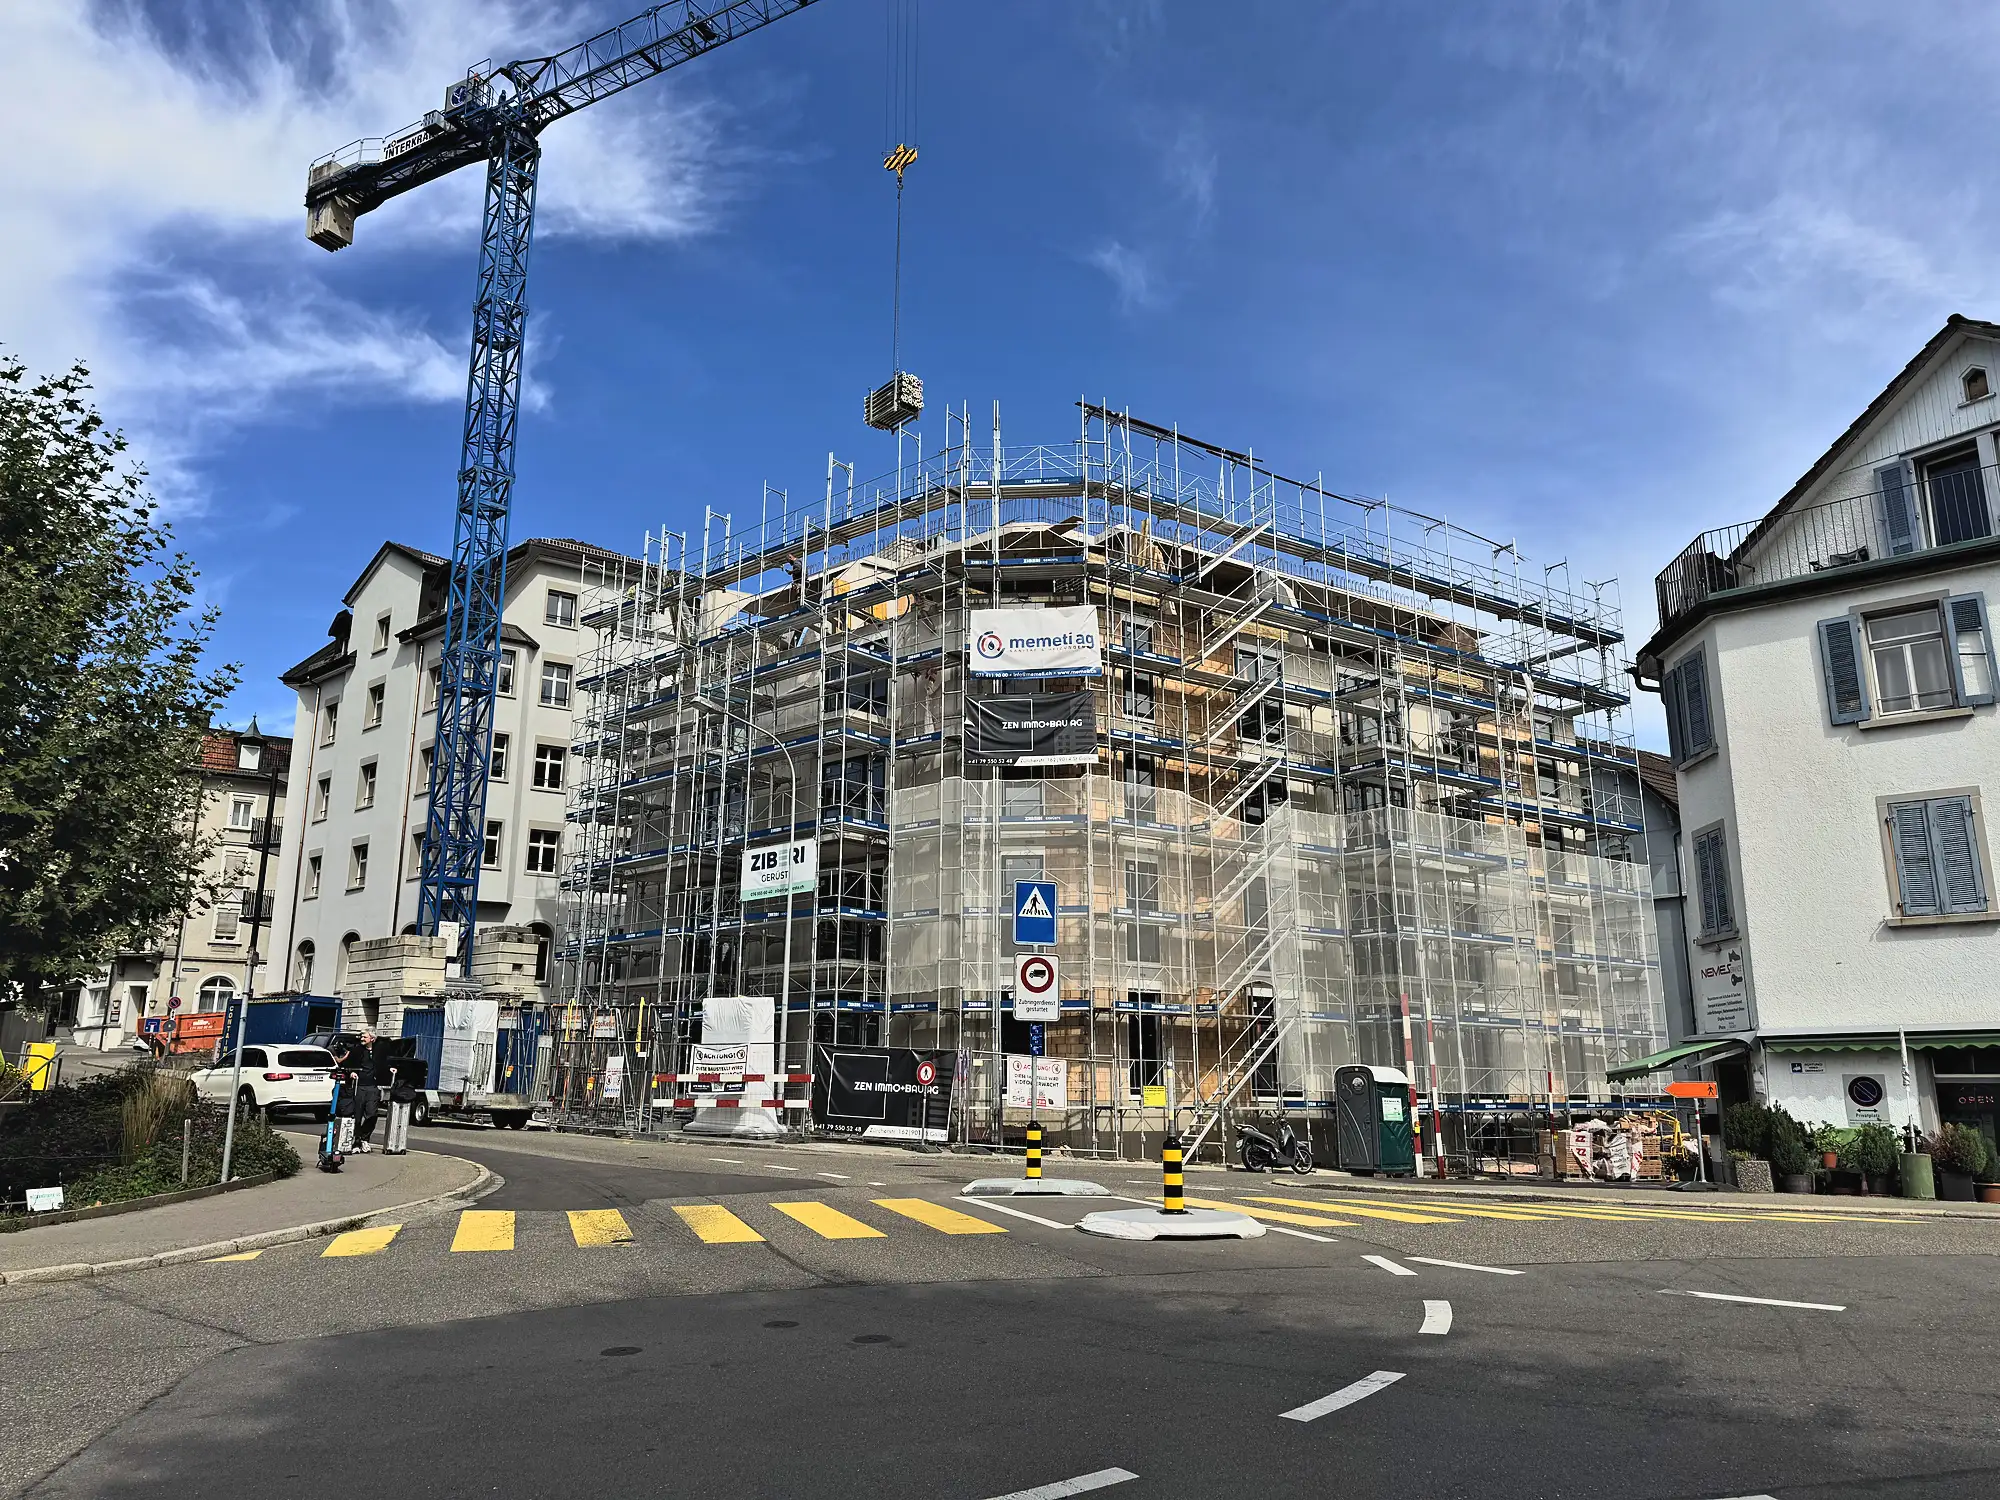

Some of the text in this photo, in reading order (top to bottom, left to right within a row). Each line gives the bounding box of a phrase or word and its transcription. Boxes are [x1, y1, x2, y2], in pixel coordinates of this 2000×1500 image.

[384, 131, 431, 160] INTERKRA
[1009, 632, 1095, 650] memeti ag
[1002, 718, 1083, 730] ZEN IMMO+BAU AG
[761, 870, 789, 883] GERÜST
[1018, 998, 1056, 1006] Zubringerdienst
[703, 1052, 736, 1060] ACHTUNG!
[853, 1081, 939, 1095] ZEN IMMO+BAU AG
[1958, 1095, 1994, 1104] OPEN
